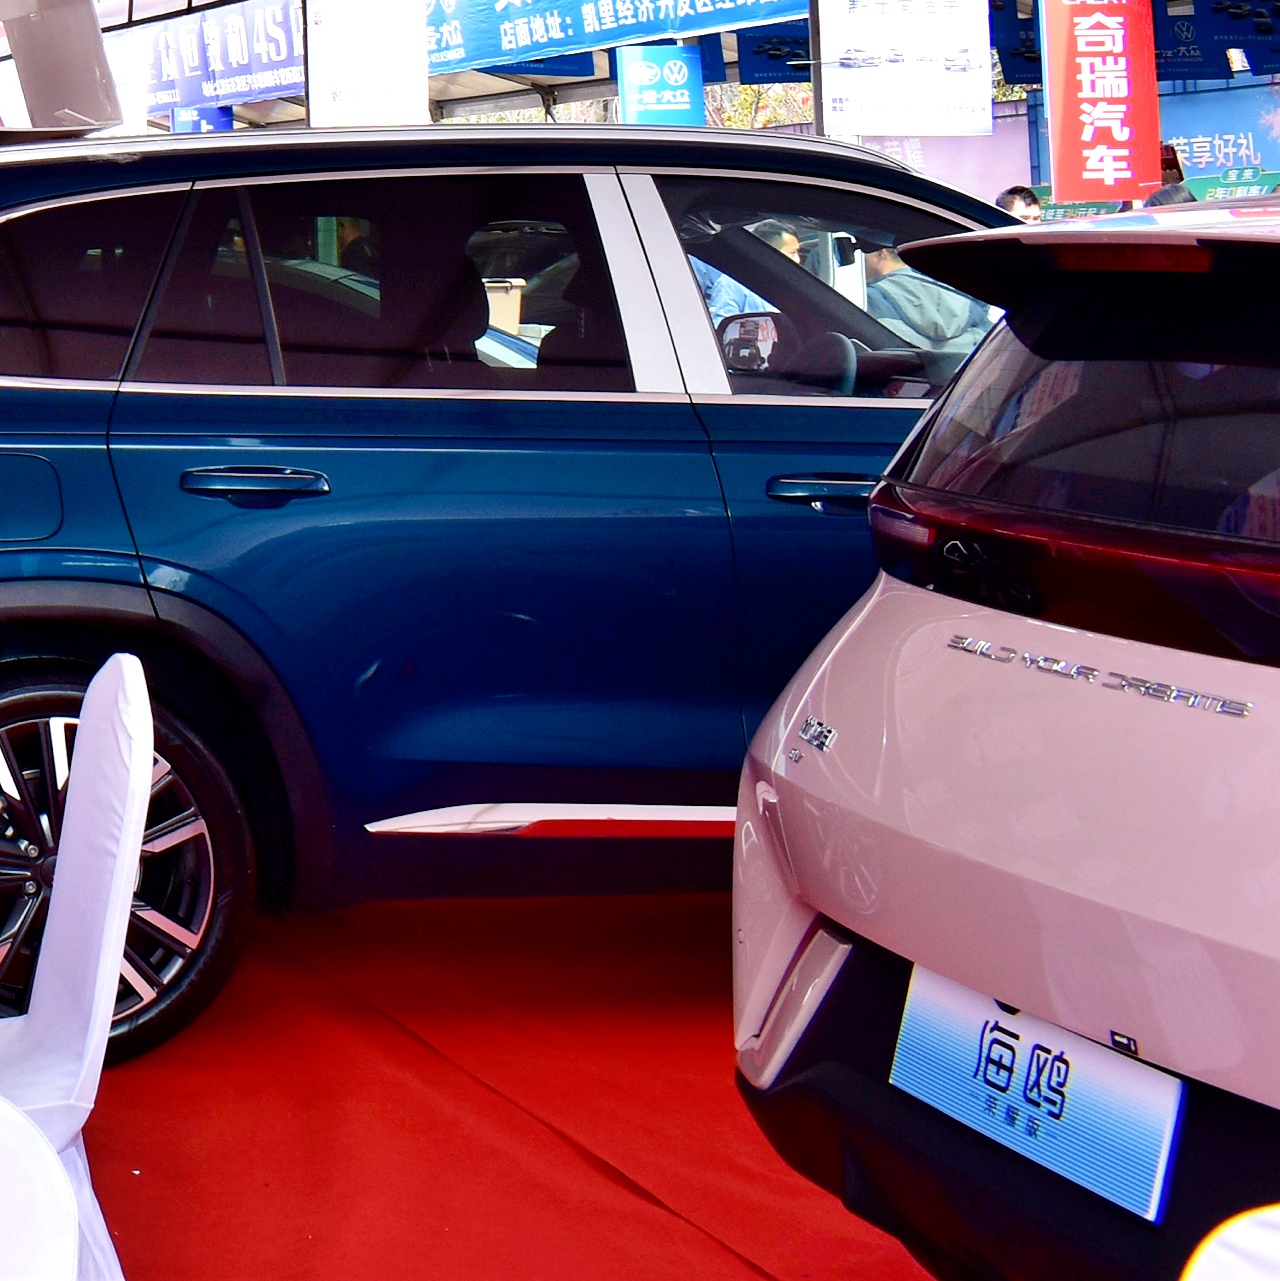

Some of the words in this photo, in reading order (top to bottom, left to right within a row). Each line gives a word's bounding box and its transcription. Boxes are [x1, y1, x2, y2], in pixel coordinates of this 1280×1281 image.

[1073, 12, 1132, 186] 奇瑞汽车
[947, 634, 1017, 663] BUILD
[1022, 651, 1100, 683] YOUR
[1102, 671, 1256, 719] DREAMS
[972, 1019, 1070, 1121] 海鸥
